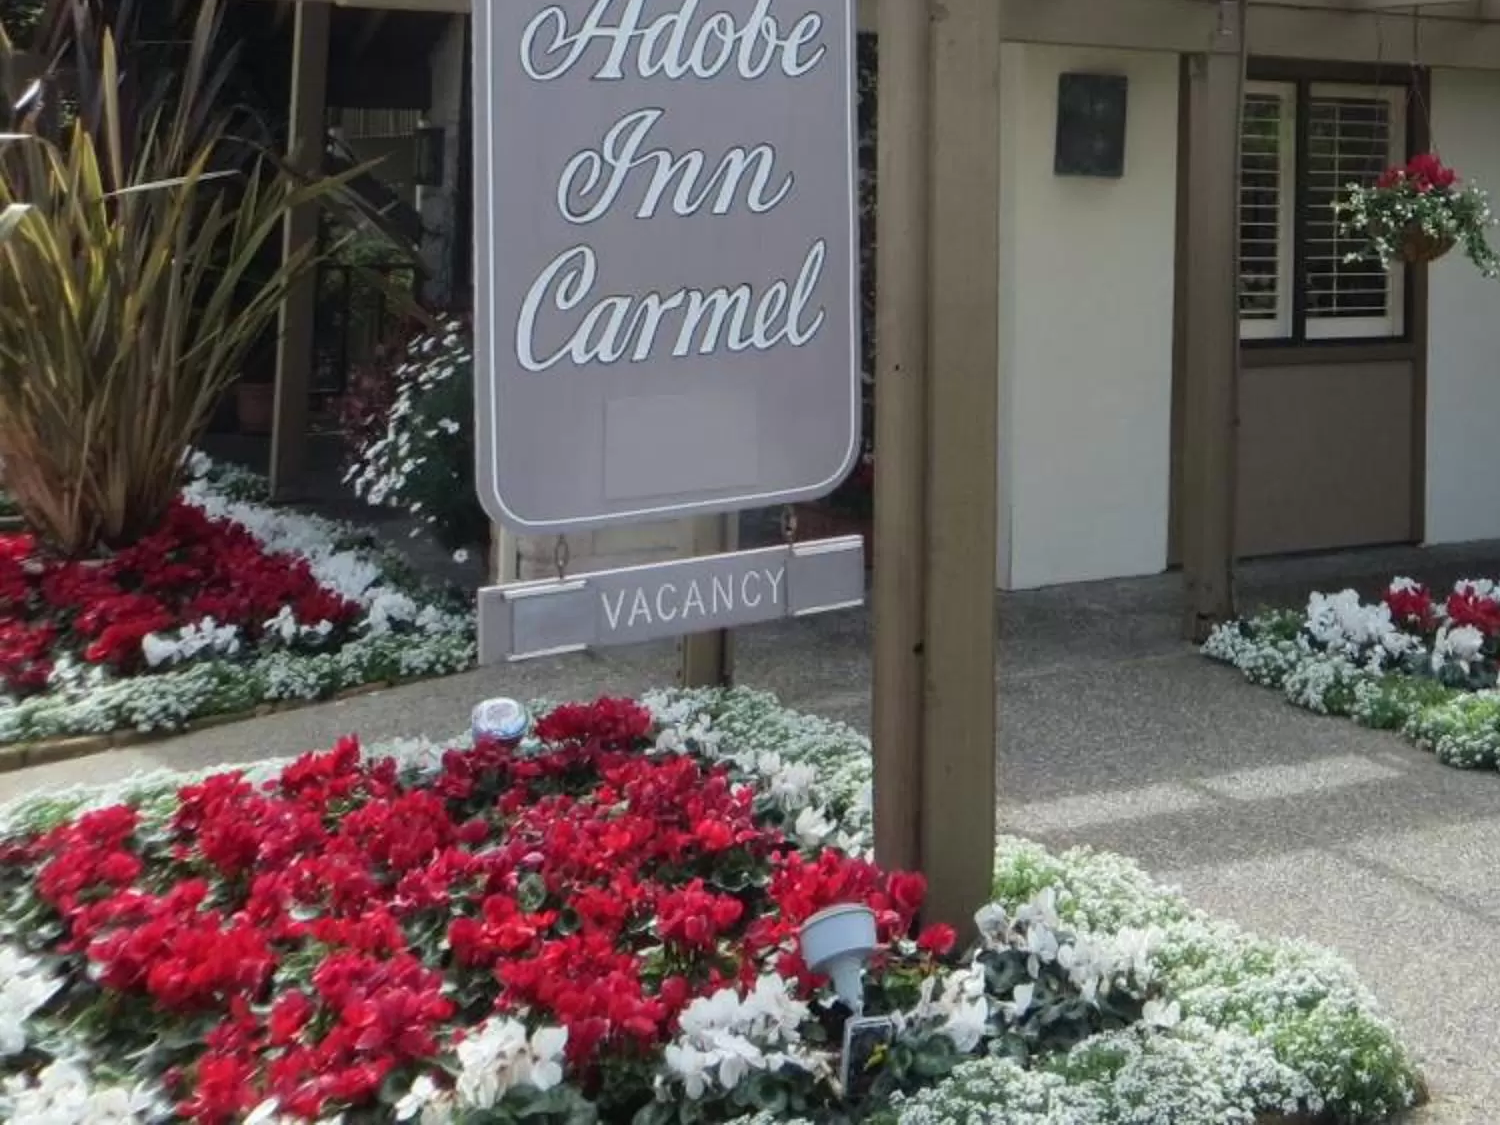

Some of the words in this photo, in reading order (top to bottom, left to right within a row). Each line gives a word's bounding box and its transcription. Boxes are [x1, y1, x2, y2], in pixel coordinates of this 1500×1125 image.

[557, 108, 793, 223] Inn
[515, 240, 826, 371] Carmel
[602, 567, 786, 630] VACANCY
